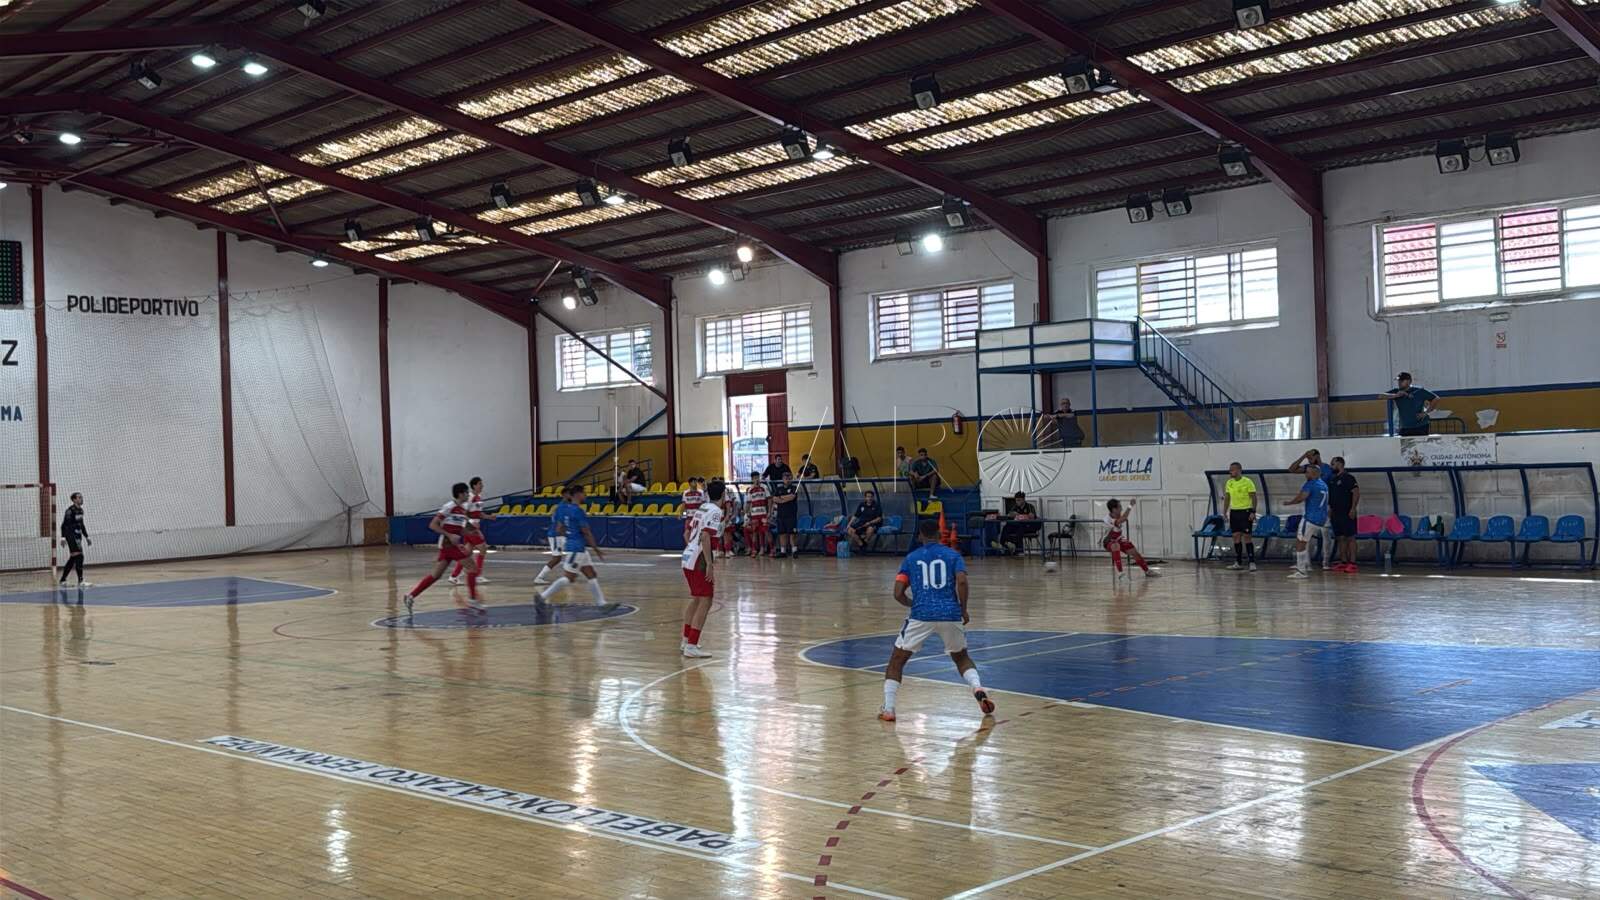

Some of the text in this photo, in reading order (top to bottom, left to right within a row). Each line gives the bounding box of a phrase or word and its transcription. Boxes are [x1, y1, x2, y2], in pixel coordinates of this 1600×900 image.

[67, 294, 199, 317] POLIDEPORTIVO
[1098, 457, 1153, 474] MELILLA
[916, 559, 947, 590] 10
